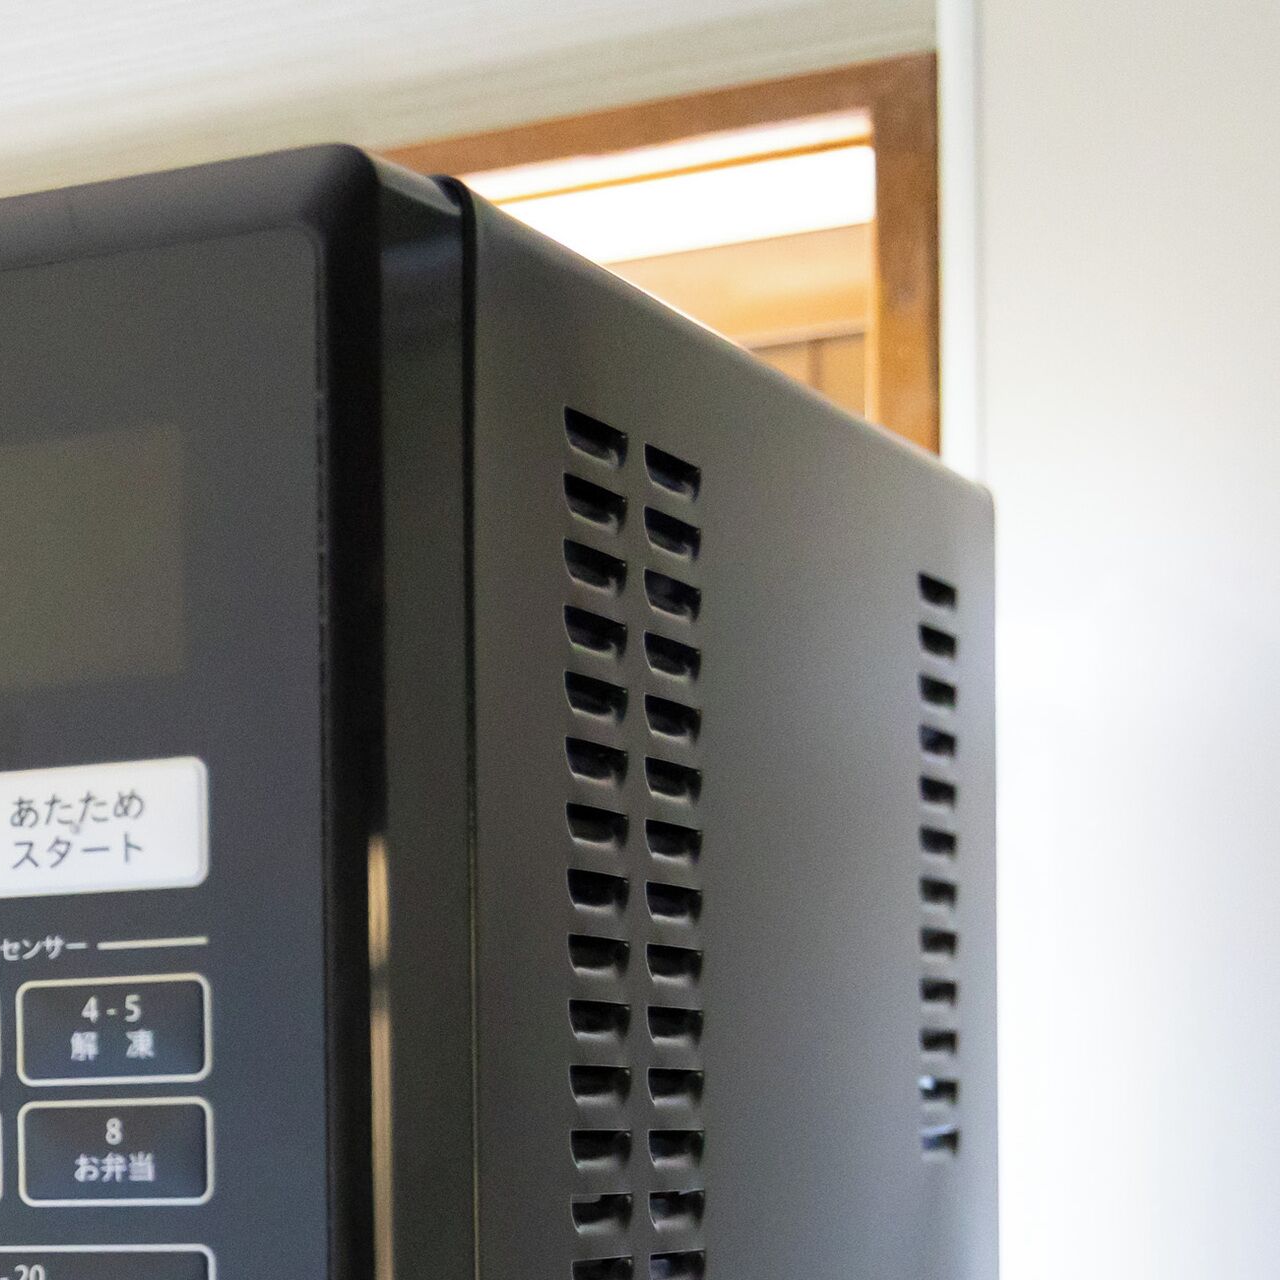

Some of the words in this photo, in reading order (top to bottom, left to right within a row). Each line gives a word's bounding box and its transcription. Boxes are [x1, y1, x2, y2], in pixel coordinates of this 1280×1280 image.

[9, 789, 145, 829] あたため
[10, 832, 145, 870] スタート
[105, 1117, 123, 1146] 8
[73, 1152, 156, 1184] お弁当
